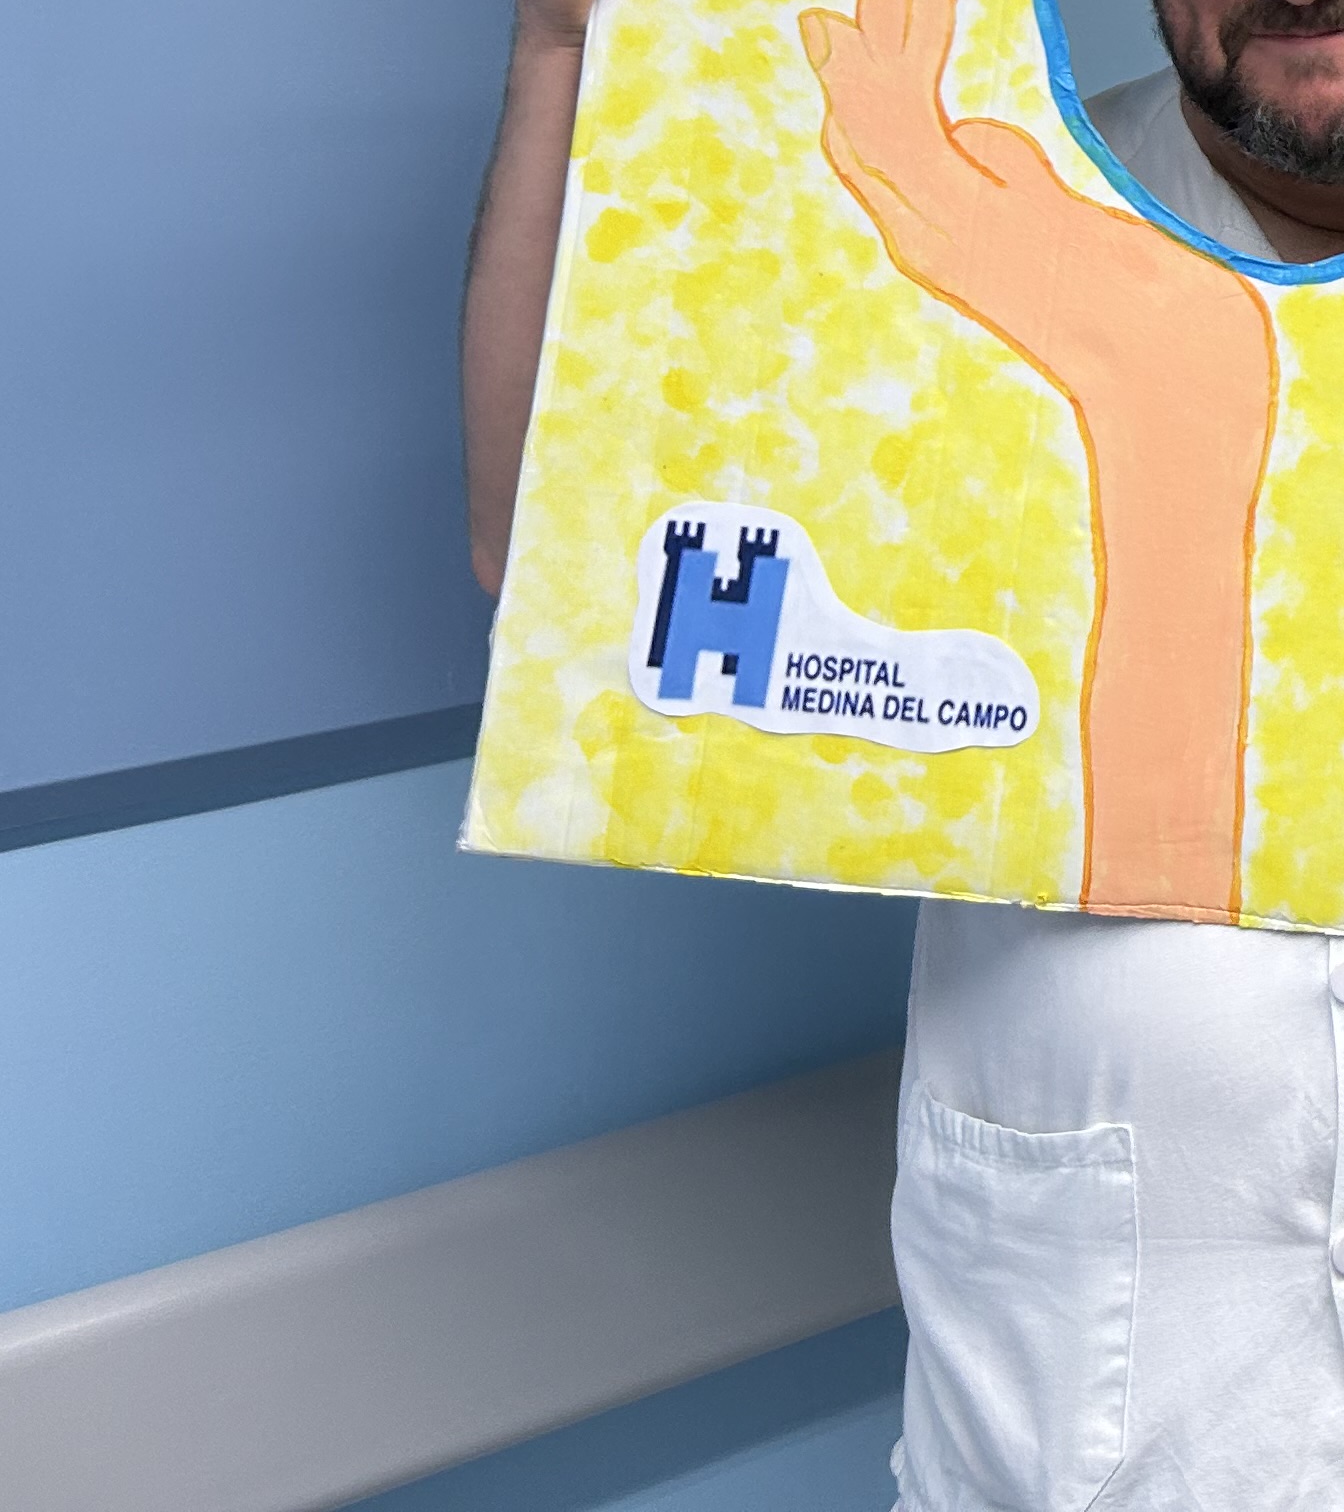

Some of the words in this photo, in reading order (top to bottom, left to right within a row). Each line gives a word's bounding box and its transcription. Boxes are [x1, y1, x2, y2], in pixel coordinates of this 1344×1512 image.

[785, 652, 906, 688] HOSPITAL
[781, 686, 875, 719] MEDINA
[883, 694, 930, 724] DEL
[936, 699, 1028, 732] CAMPO
